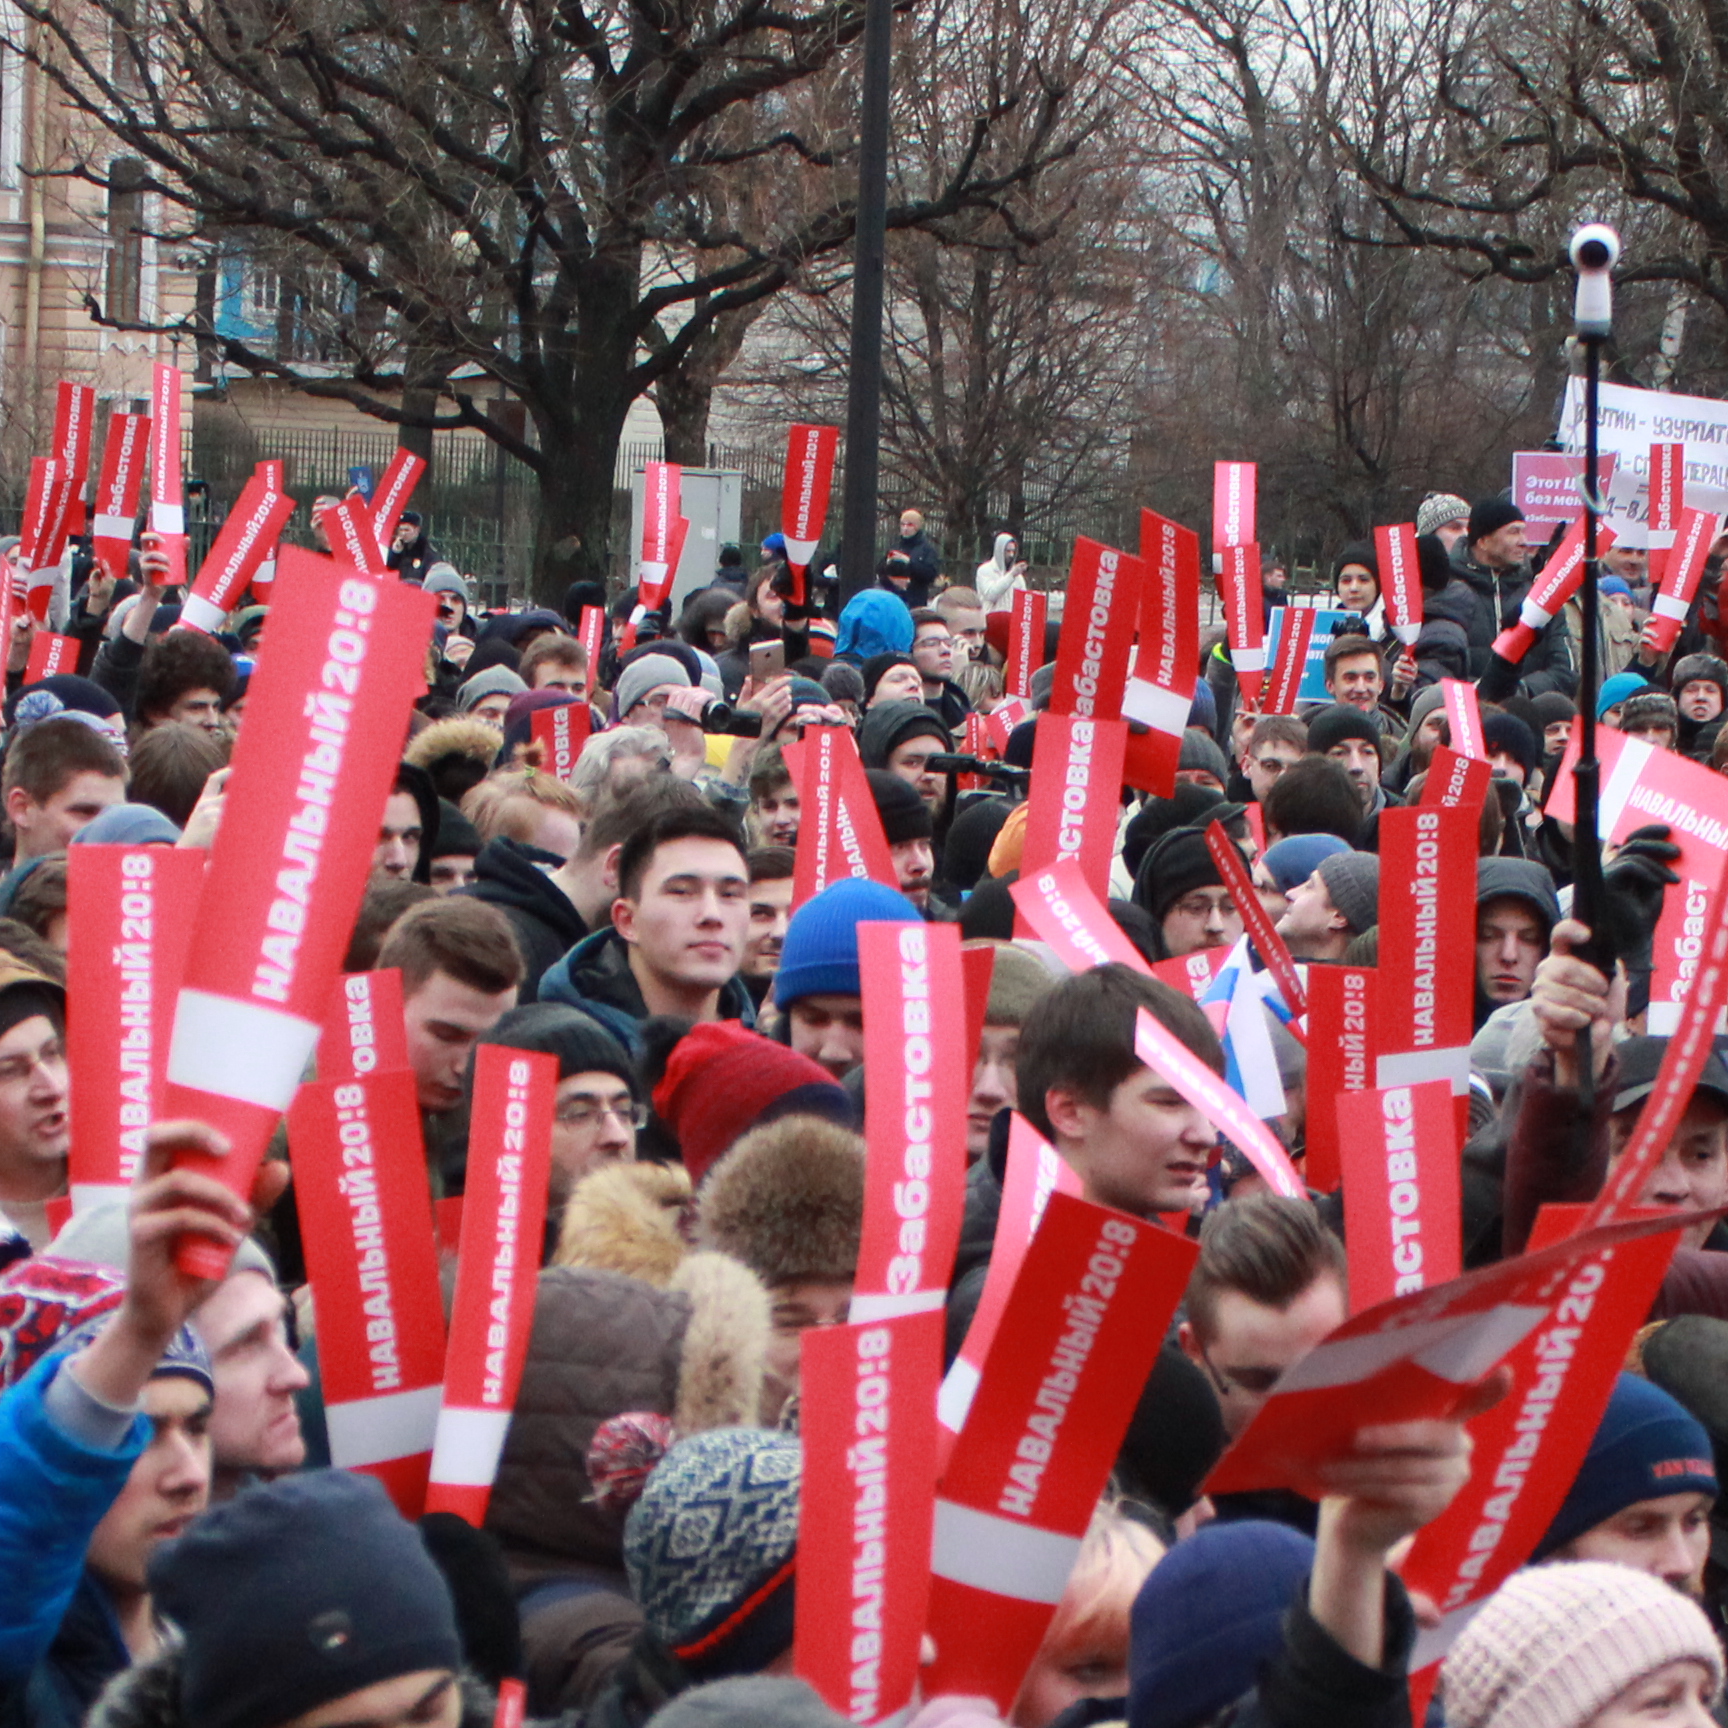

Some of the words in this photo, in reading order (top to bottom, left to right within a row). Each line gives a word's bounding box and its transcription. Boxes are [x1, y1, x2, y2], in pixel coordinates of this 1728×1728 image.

[1225, 464, 1242, 546] абастовка
[1525, 491, 1551, 505] без
[1526, 475, 1562, 489] Этот
[1073, 550, 1119, 720] абастовка
[1057, 721, 1095, 864] стовка
[1383, 1087, 1424, 1296] астовка
